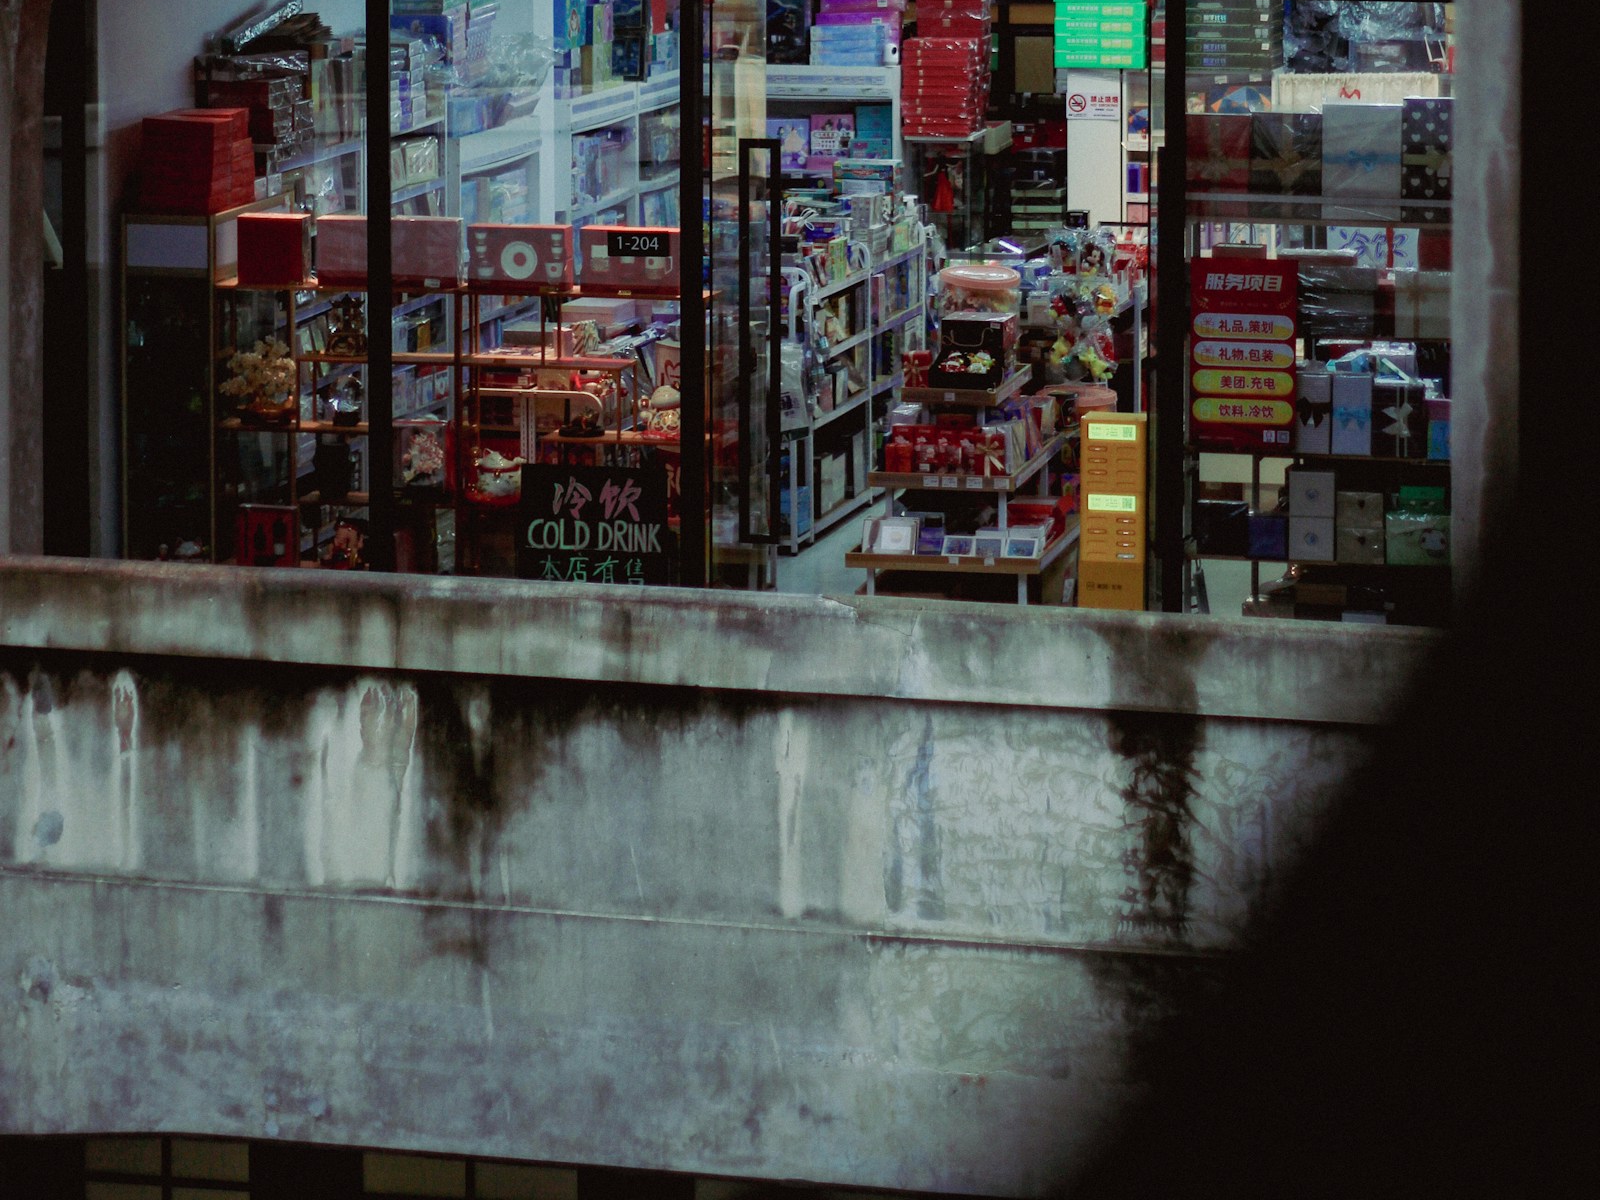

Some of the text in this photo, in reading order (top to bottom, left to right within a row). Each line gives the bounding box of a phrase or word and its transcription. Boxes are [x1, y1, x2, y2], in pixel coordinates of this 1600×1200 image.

[616, 235, 659, 251] 1-204
[1205, 273, 1283, 292] 服务项目
[552, 476, 642, 522] 冷饮
[527, 518, 661, 553] COLD DRINK
[539, 553, 645, 585] 本店有售
